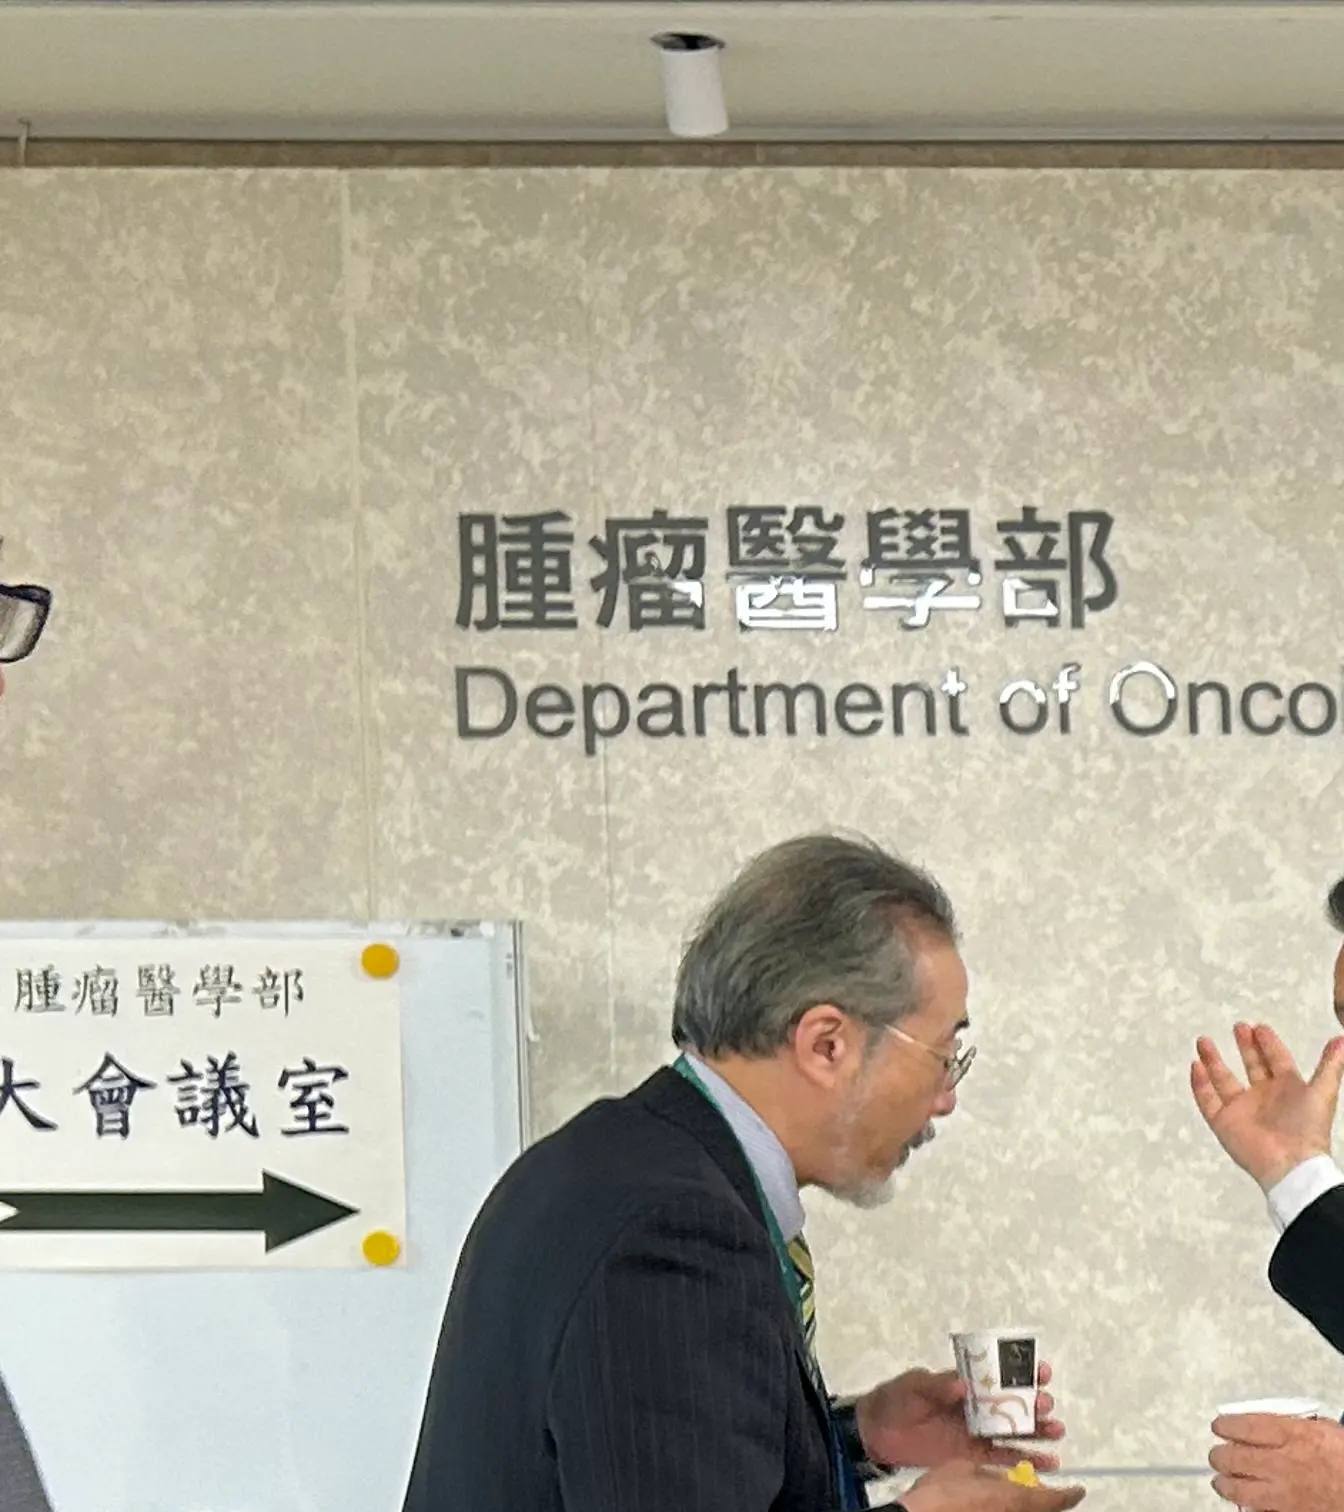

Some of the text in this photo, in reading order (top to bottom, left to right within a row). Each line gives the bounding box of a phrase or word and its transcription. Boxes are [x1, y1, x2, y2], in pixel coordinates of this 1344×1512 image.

[455, 506, 1119, 632] 腫瘤醫學部
[454, 666, 969, 757] Department
[999, 662, 1081, 735] of
[14, 963, 305, 1018] 腫瘤醫學部
